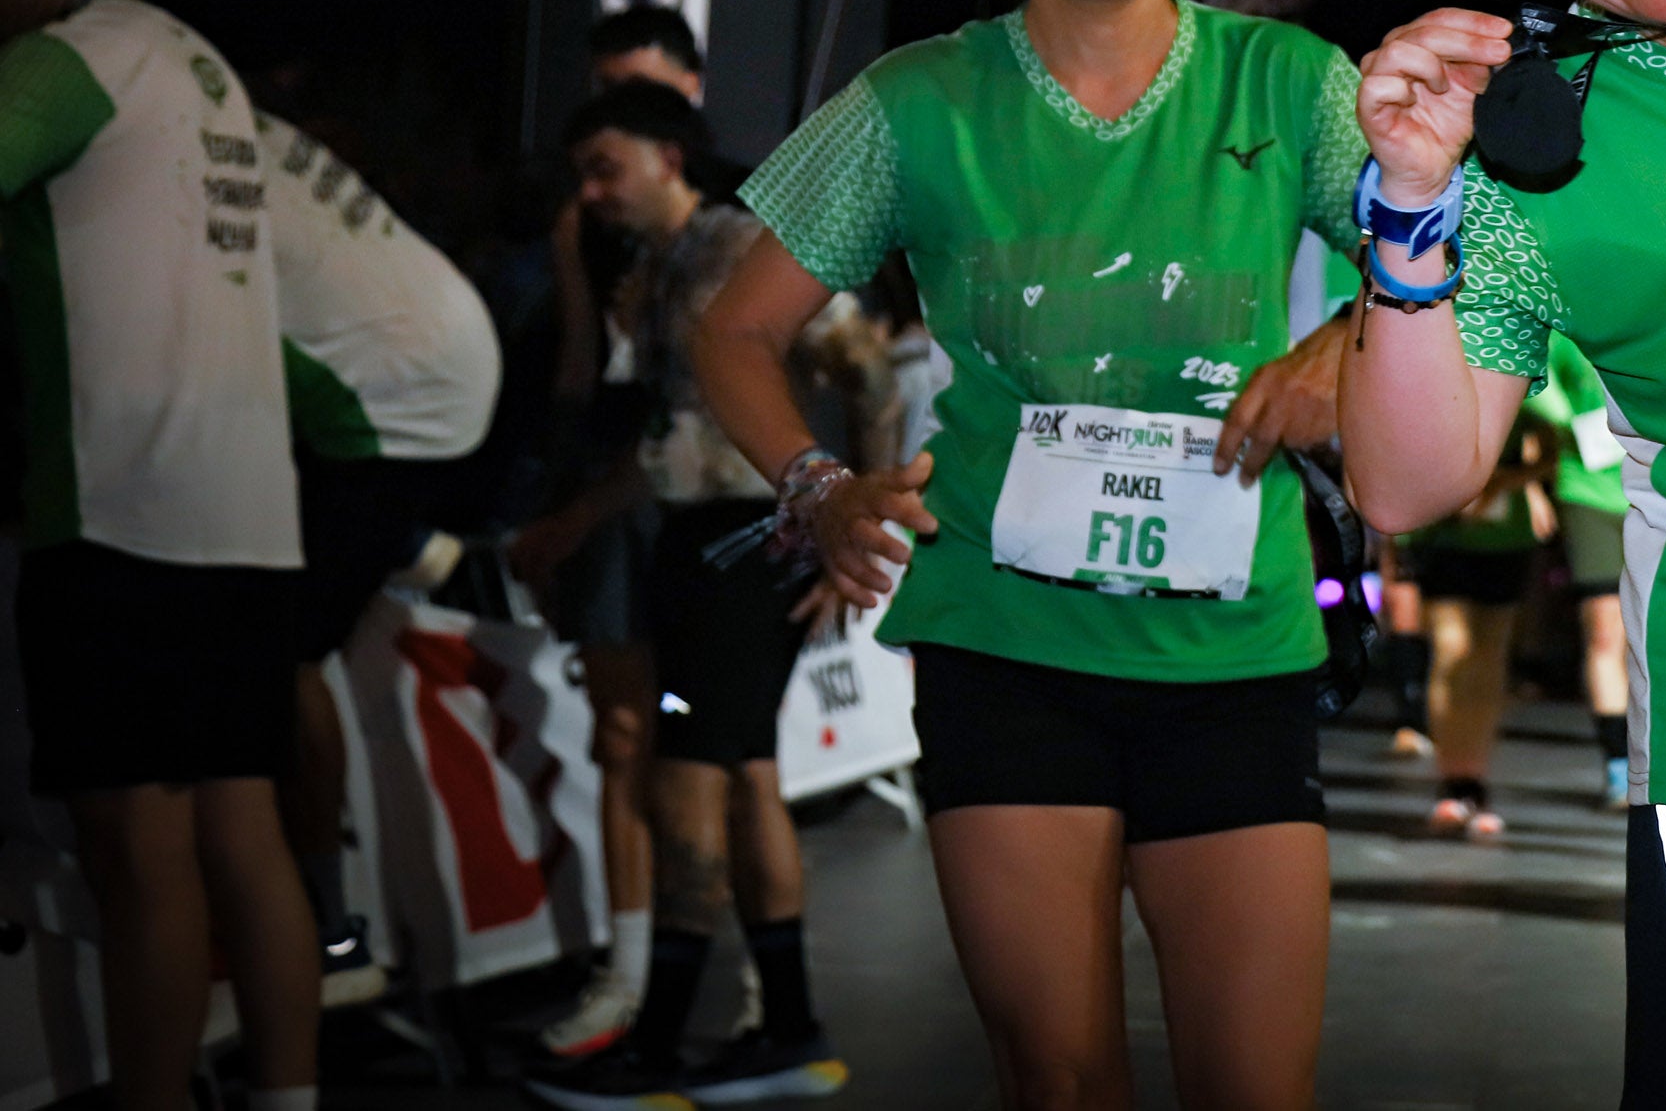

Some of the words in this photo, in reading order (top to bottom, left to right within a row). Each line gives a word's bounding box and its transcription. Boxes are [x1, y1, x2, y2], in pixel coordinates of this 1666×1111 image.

[1180, 356, 1240, 388] 2025
[1030, 409, 1068, 437] 10K
[1101, 471, 1164, 501] RAKEL
[1085, 510, 1168, 568] F16
